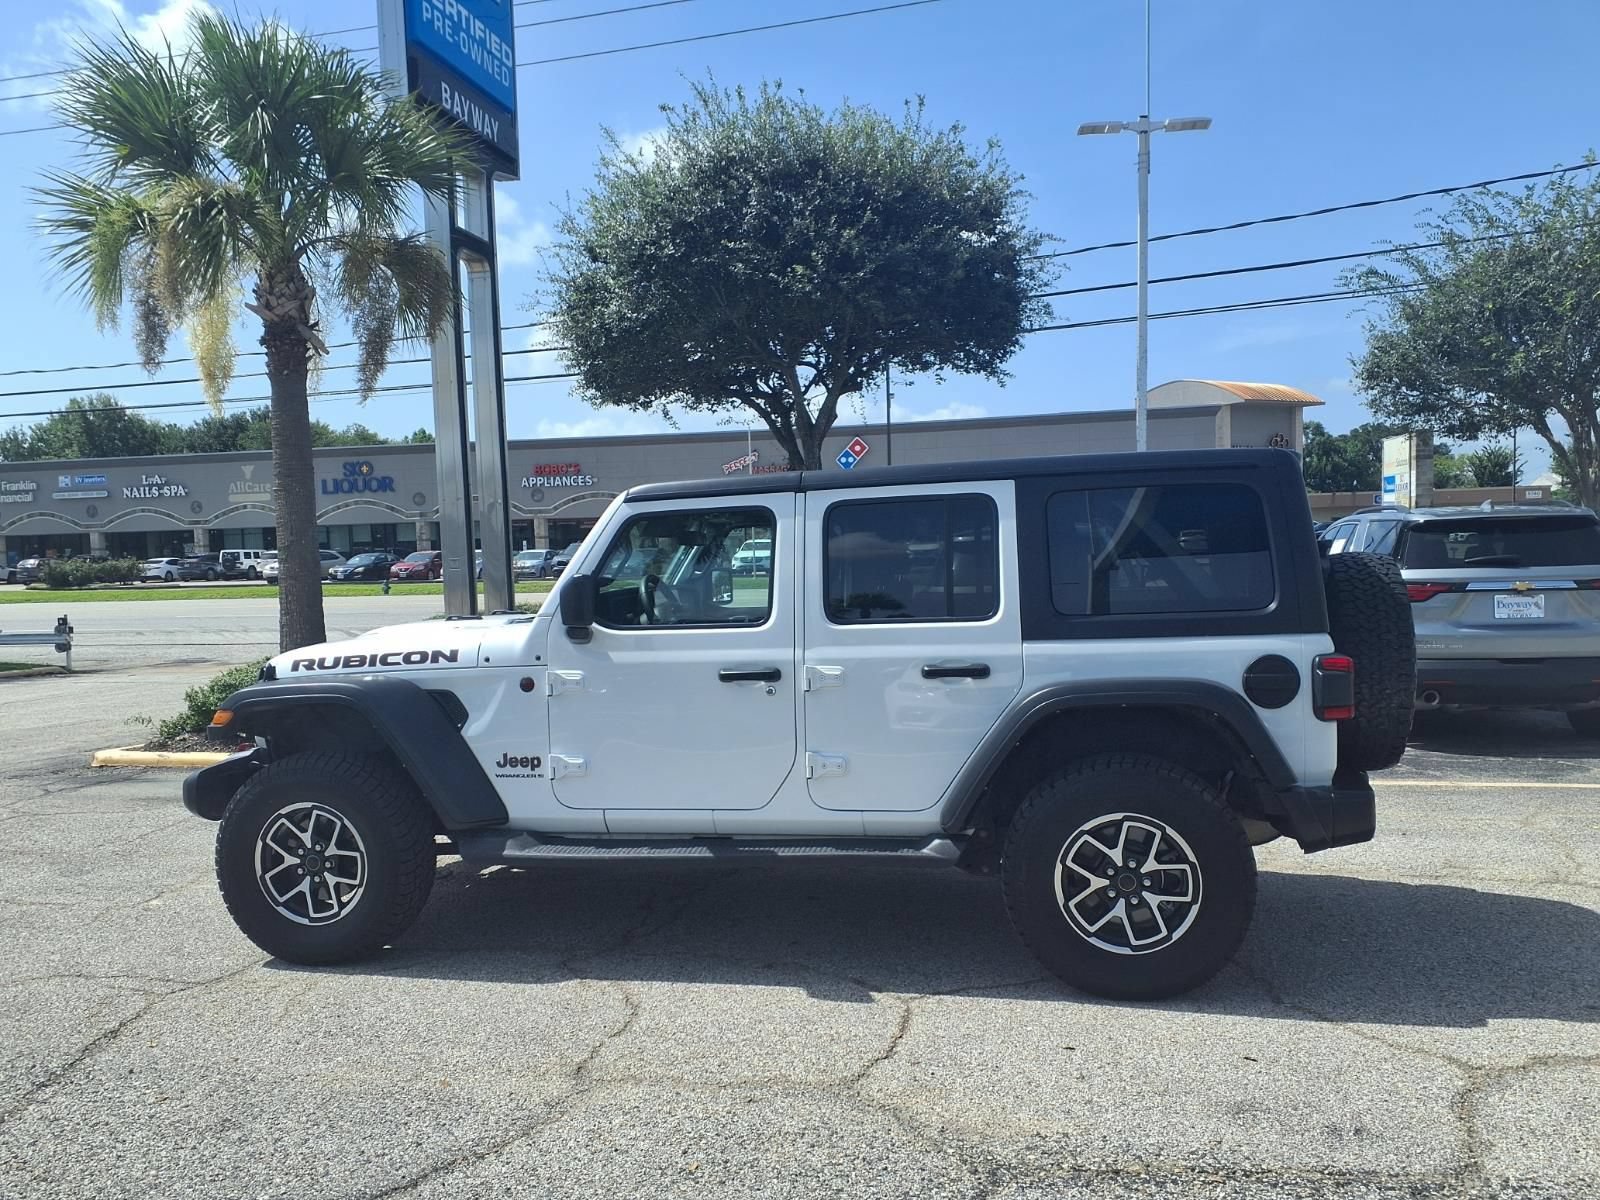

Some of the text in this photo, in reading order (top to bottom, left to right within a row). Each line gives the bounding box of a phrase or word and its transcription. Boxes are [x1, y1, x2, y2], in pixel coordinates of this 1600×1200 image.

[422, 1, 510, 87] PRE-OWNED
[440, 81, 499, 142] BAYWAY
[1, 480, 37, 491] Franklin
[321, 477, 396, 495] LIQUOR
[521, 475, 593, 488] APPLIANCES
[291, 649, 459, 672] RUBICON
[496, 752, 542, 771] Jeep
